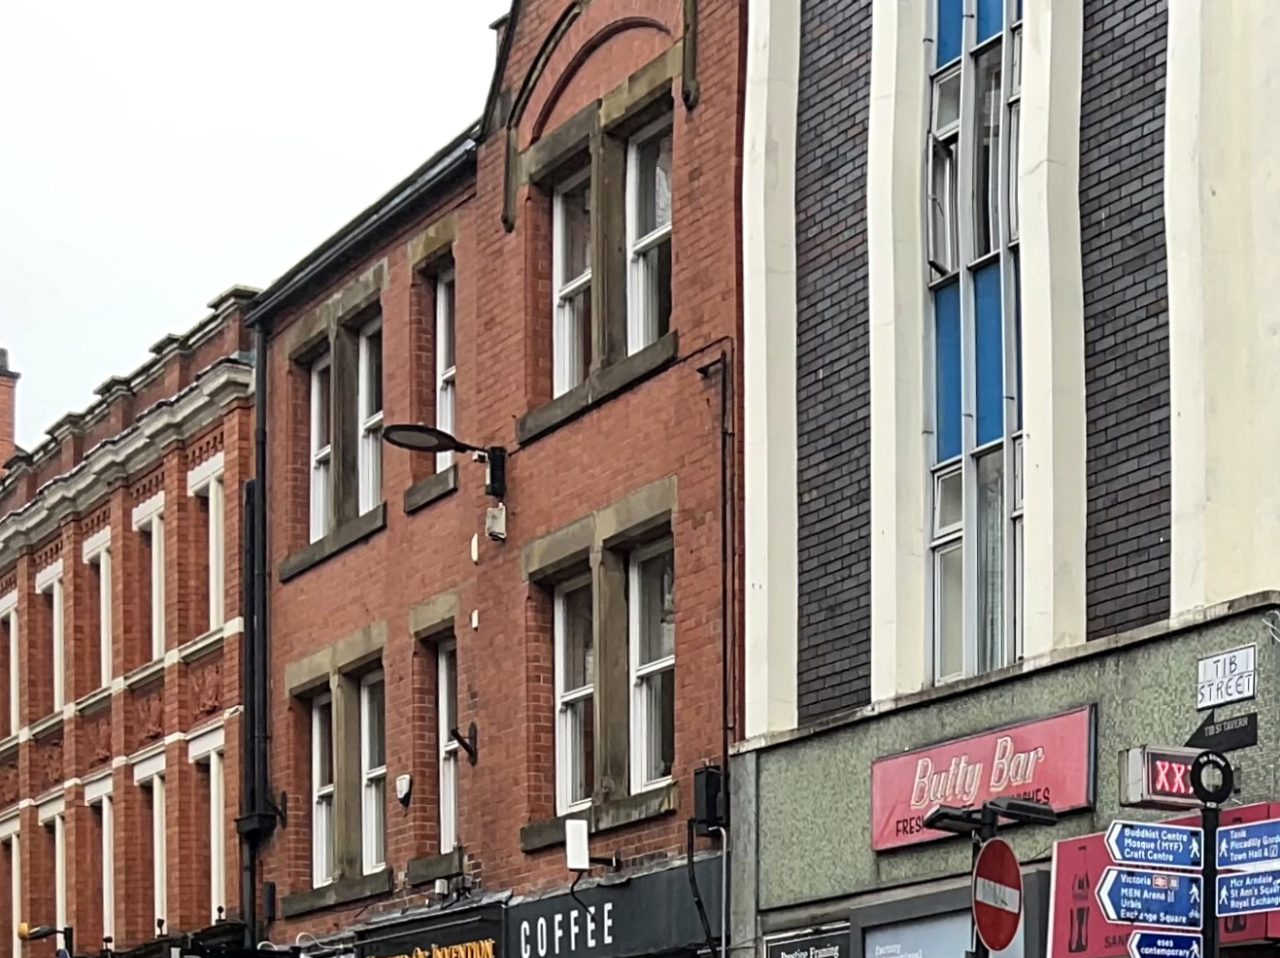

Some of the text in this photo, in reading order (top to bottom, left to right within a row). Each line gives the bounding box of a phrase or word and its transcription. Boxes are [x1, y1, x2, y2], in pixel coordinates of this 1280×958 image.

[1212, 654, 1238, 679] TIB
[1198, 673, 1253, 704] STREET
[1224, 716, 1249, 732] TAVERN
[910, 736, 1046, 811] Butty Bar
[1156, 760, 1194, 795] XX
[895, 814, 925, 837] FRES
[1124, 827, 1188, 842] Buddhist Centre
[1124, 838, 1184, 853] Mosque (MYF)
[1230, 838, 1261, 850] Piccadilly
[1124, 848, 1174, 862] Craft Centre
[1230, 852, 1247, 862] Town
[1248, 849, 1262, 859] Hall
[1120, 873, 1152, 886] Victoria
[1230, 875, 1273, 888] Mcr Arndale
[1120, 887, 1166, 901] MEN Arena
[1120, 898, 1142, 910] Urbis
[1230, 899, 1250, 910] Royal
[1159, 912, 1187, 924] Square
